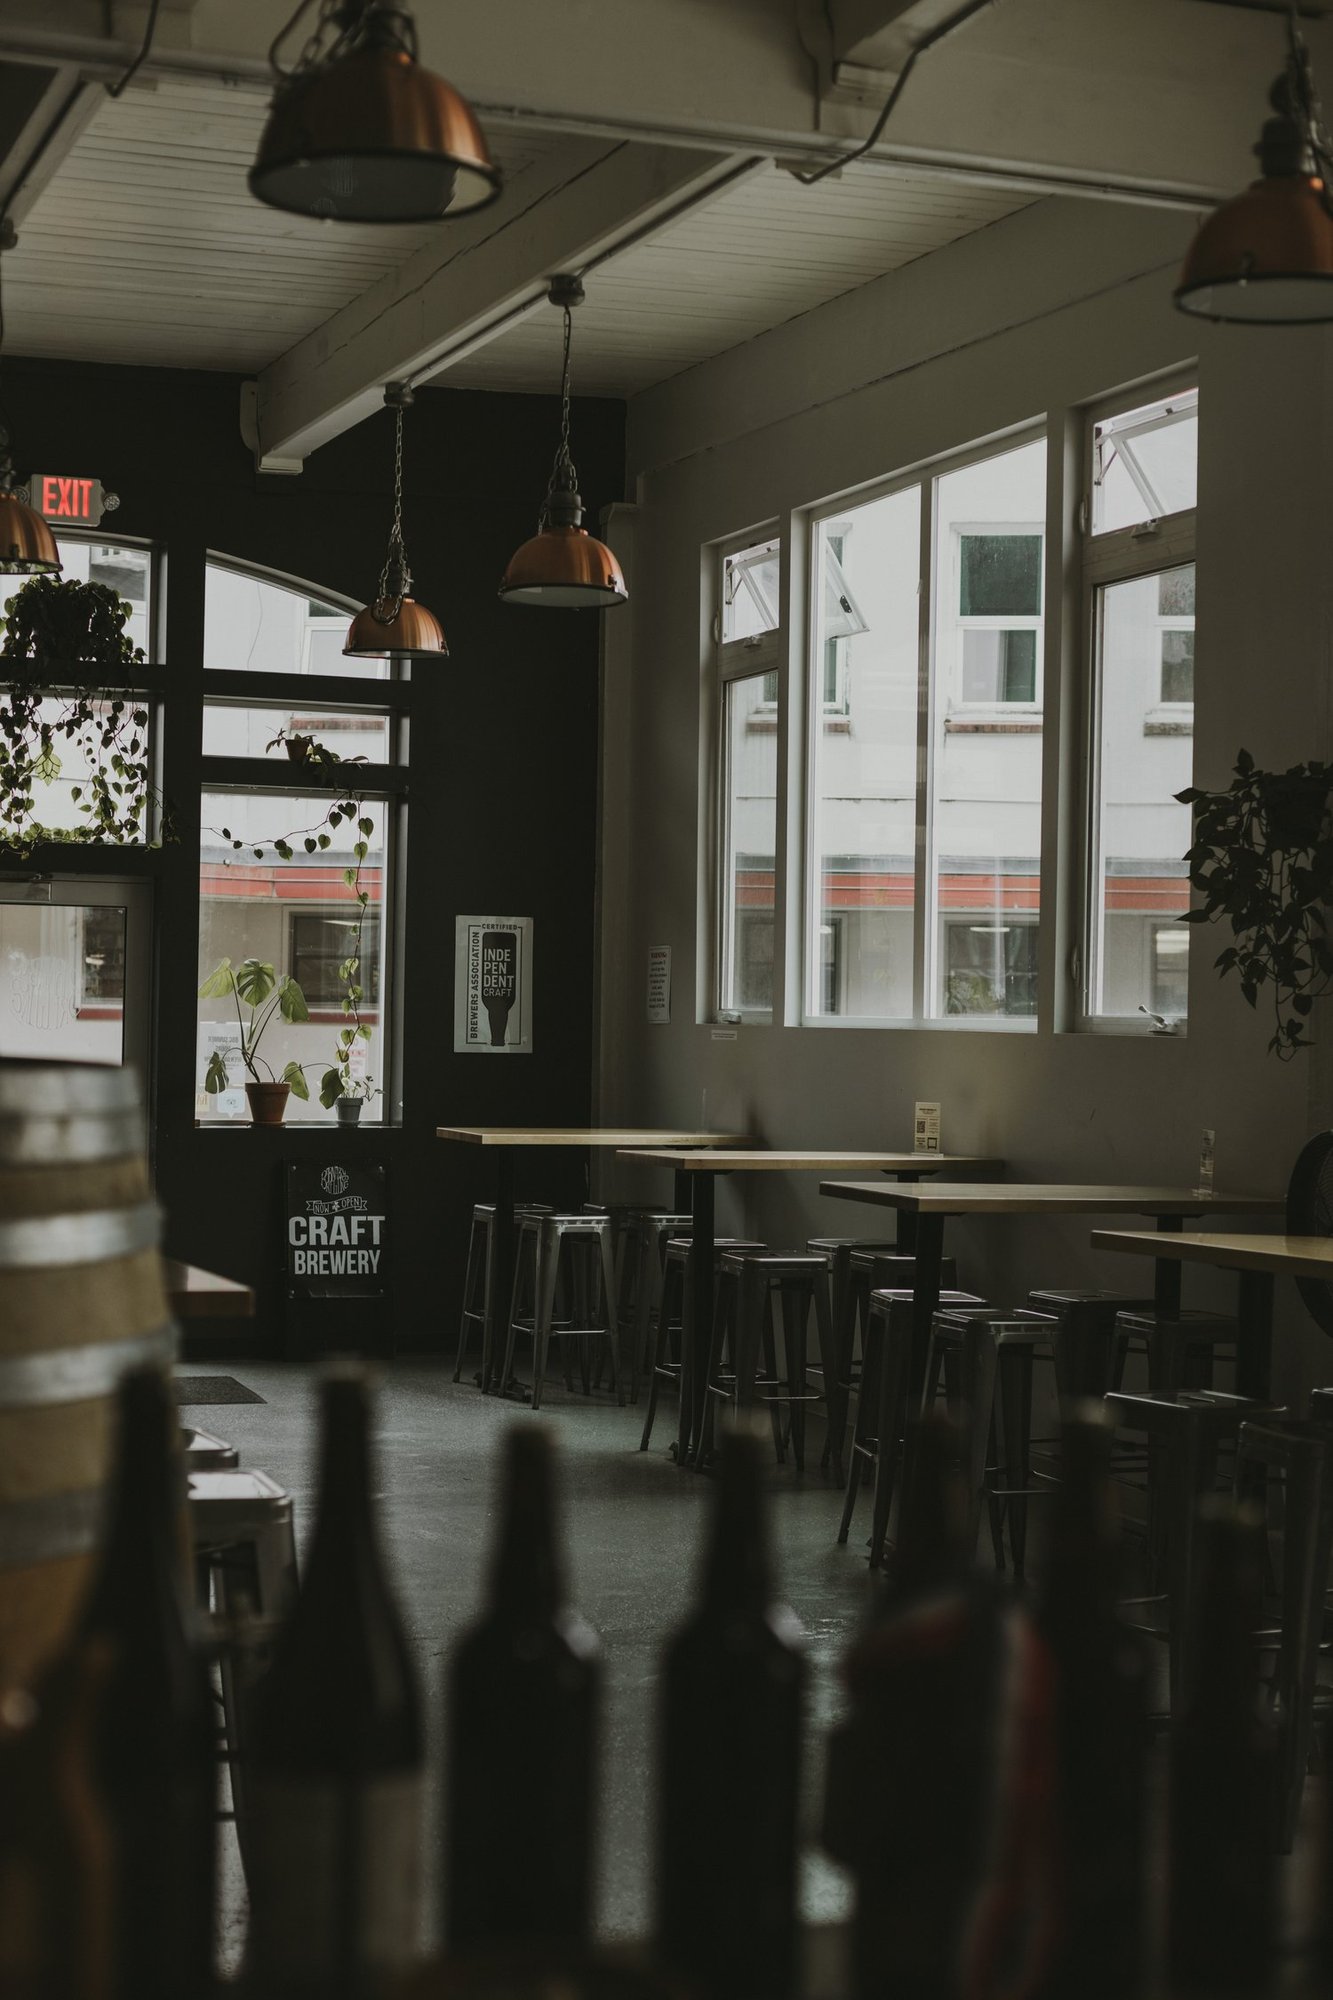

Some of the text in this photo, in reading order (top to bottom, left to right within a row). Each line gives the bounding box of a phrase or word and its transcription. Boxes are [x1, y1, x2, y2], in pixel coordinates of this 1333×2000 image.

[42, 476, 94, 518] EXIT
[483, 948, 511, 962] INDE
[483, 961, 507, 975] PEN
[470, 931, 480, 1038] BREWERS ASSOCIATION
[483, 975, 514, 988] DENT
[482, 988, 512, 997] CRAFT
[314, 1197, 360, 1214] NOW OPEN
[288, 1215, 386, 1247] CRAFT
[294, 1249, 381, 1275] BREWERY
